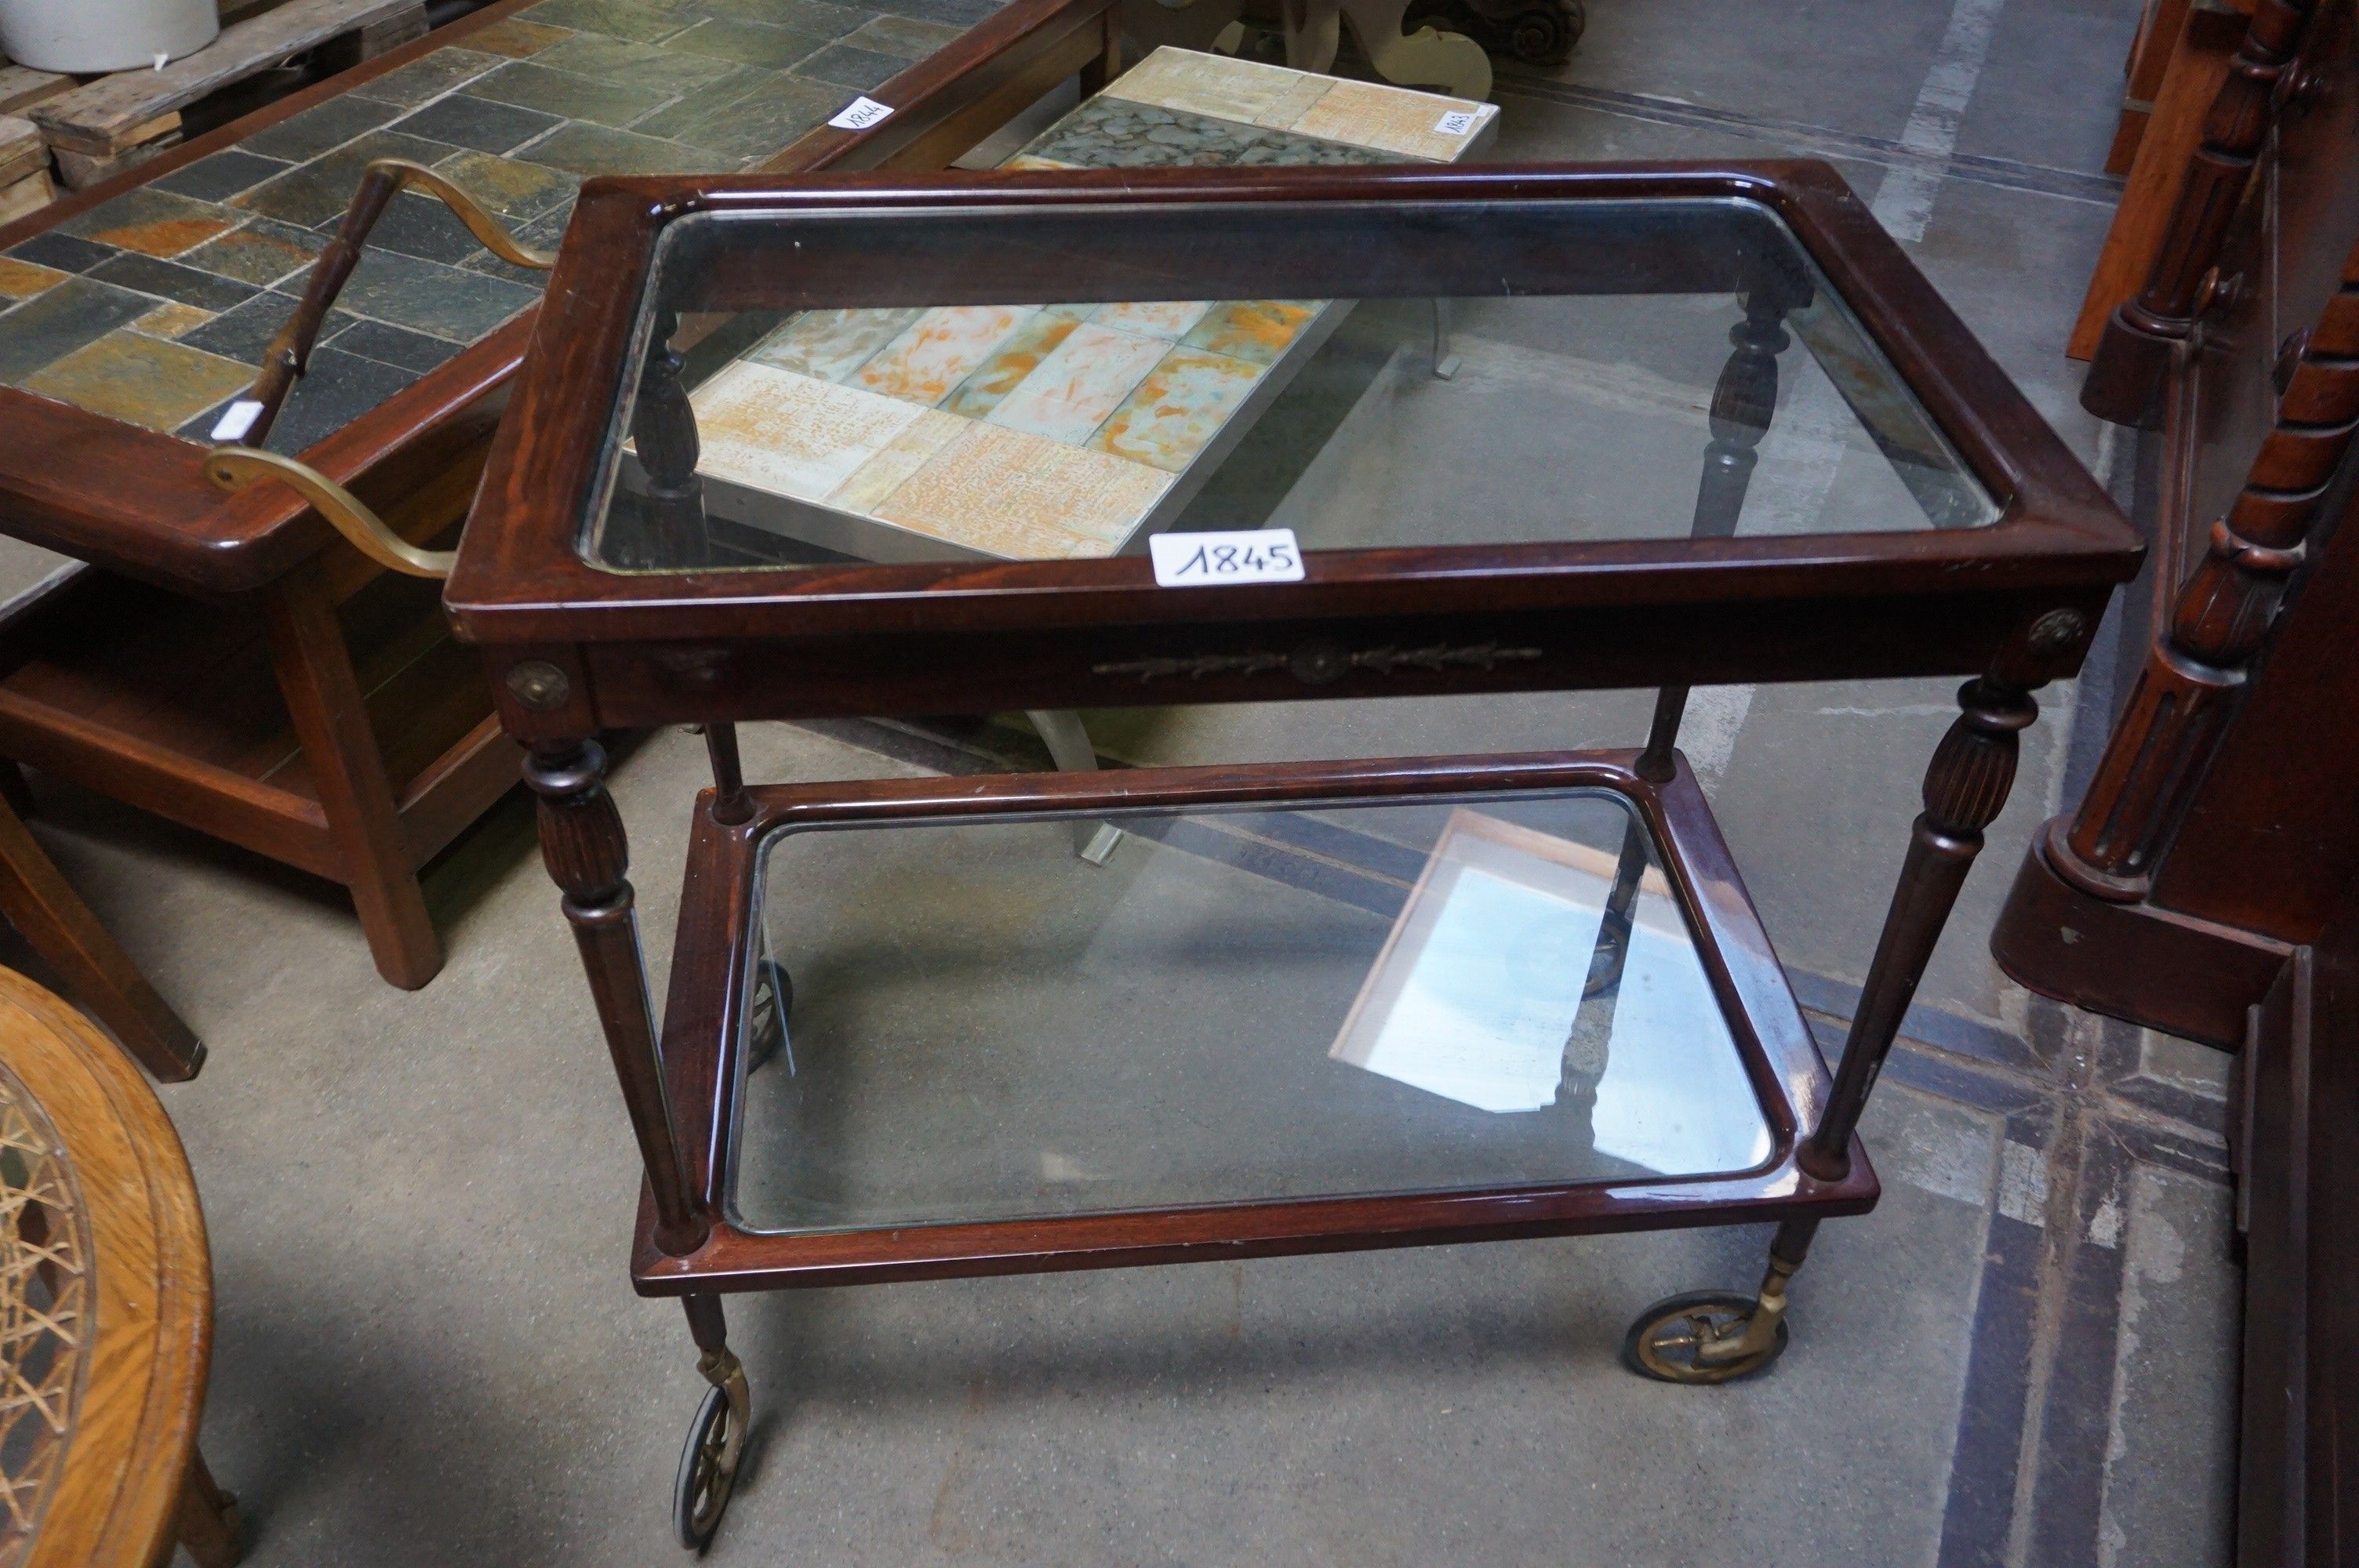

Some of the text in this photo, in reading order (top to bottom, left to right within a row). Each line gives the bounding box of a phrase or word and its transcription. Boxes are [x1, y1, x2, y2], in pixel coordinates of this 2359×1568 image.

[845, 104, 884, 127] 1844
[1445, 115, 1470, 133] 1843
[1175, 543, 1293, 576] 1845
